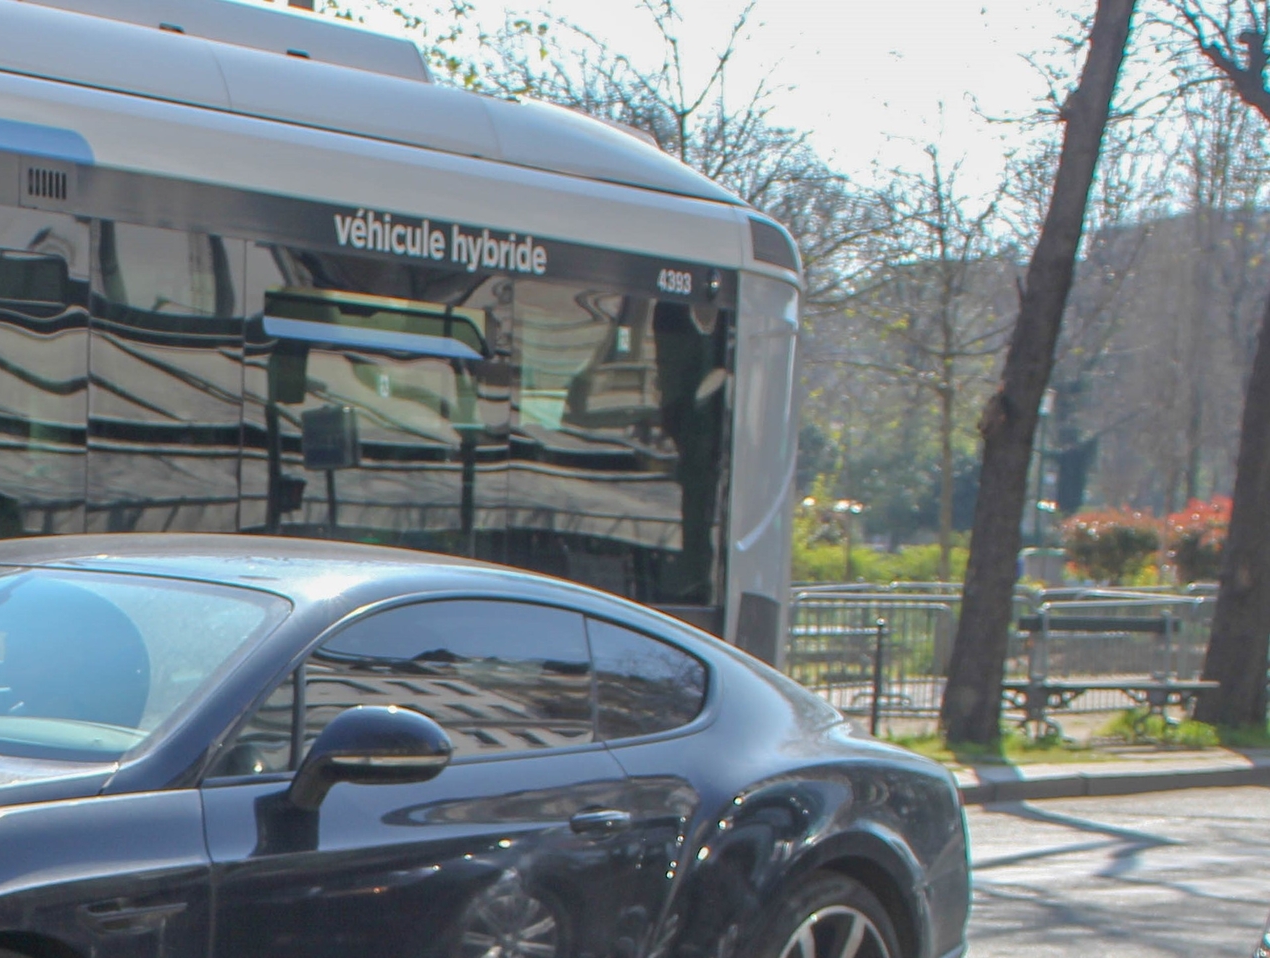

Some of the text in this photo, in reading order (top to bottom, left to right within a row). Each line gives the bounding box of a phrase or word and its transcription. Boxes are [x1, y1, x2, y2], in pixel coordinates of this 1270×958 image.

[334, 208, 547, 275] véhicule hybride
[656, 268, 692, 295] 4393
